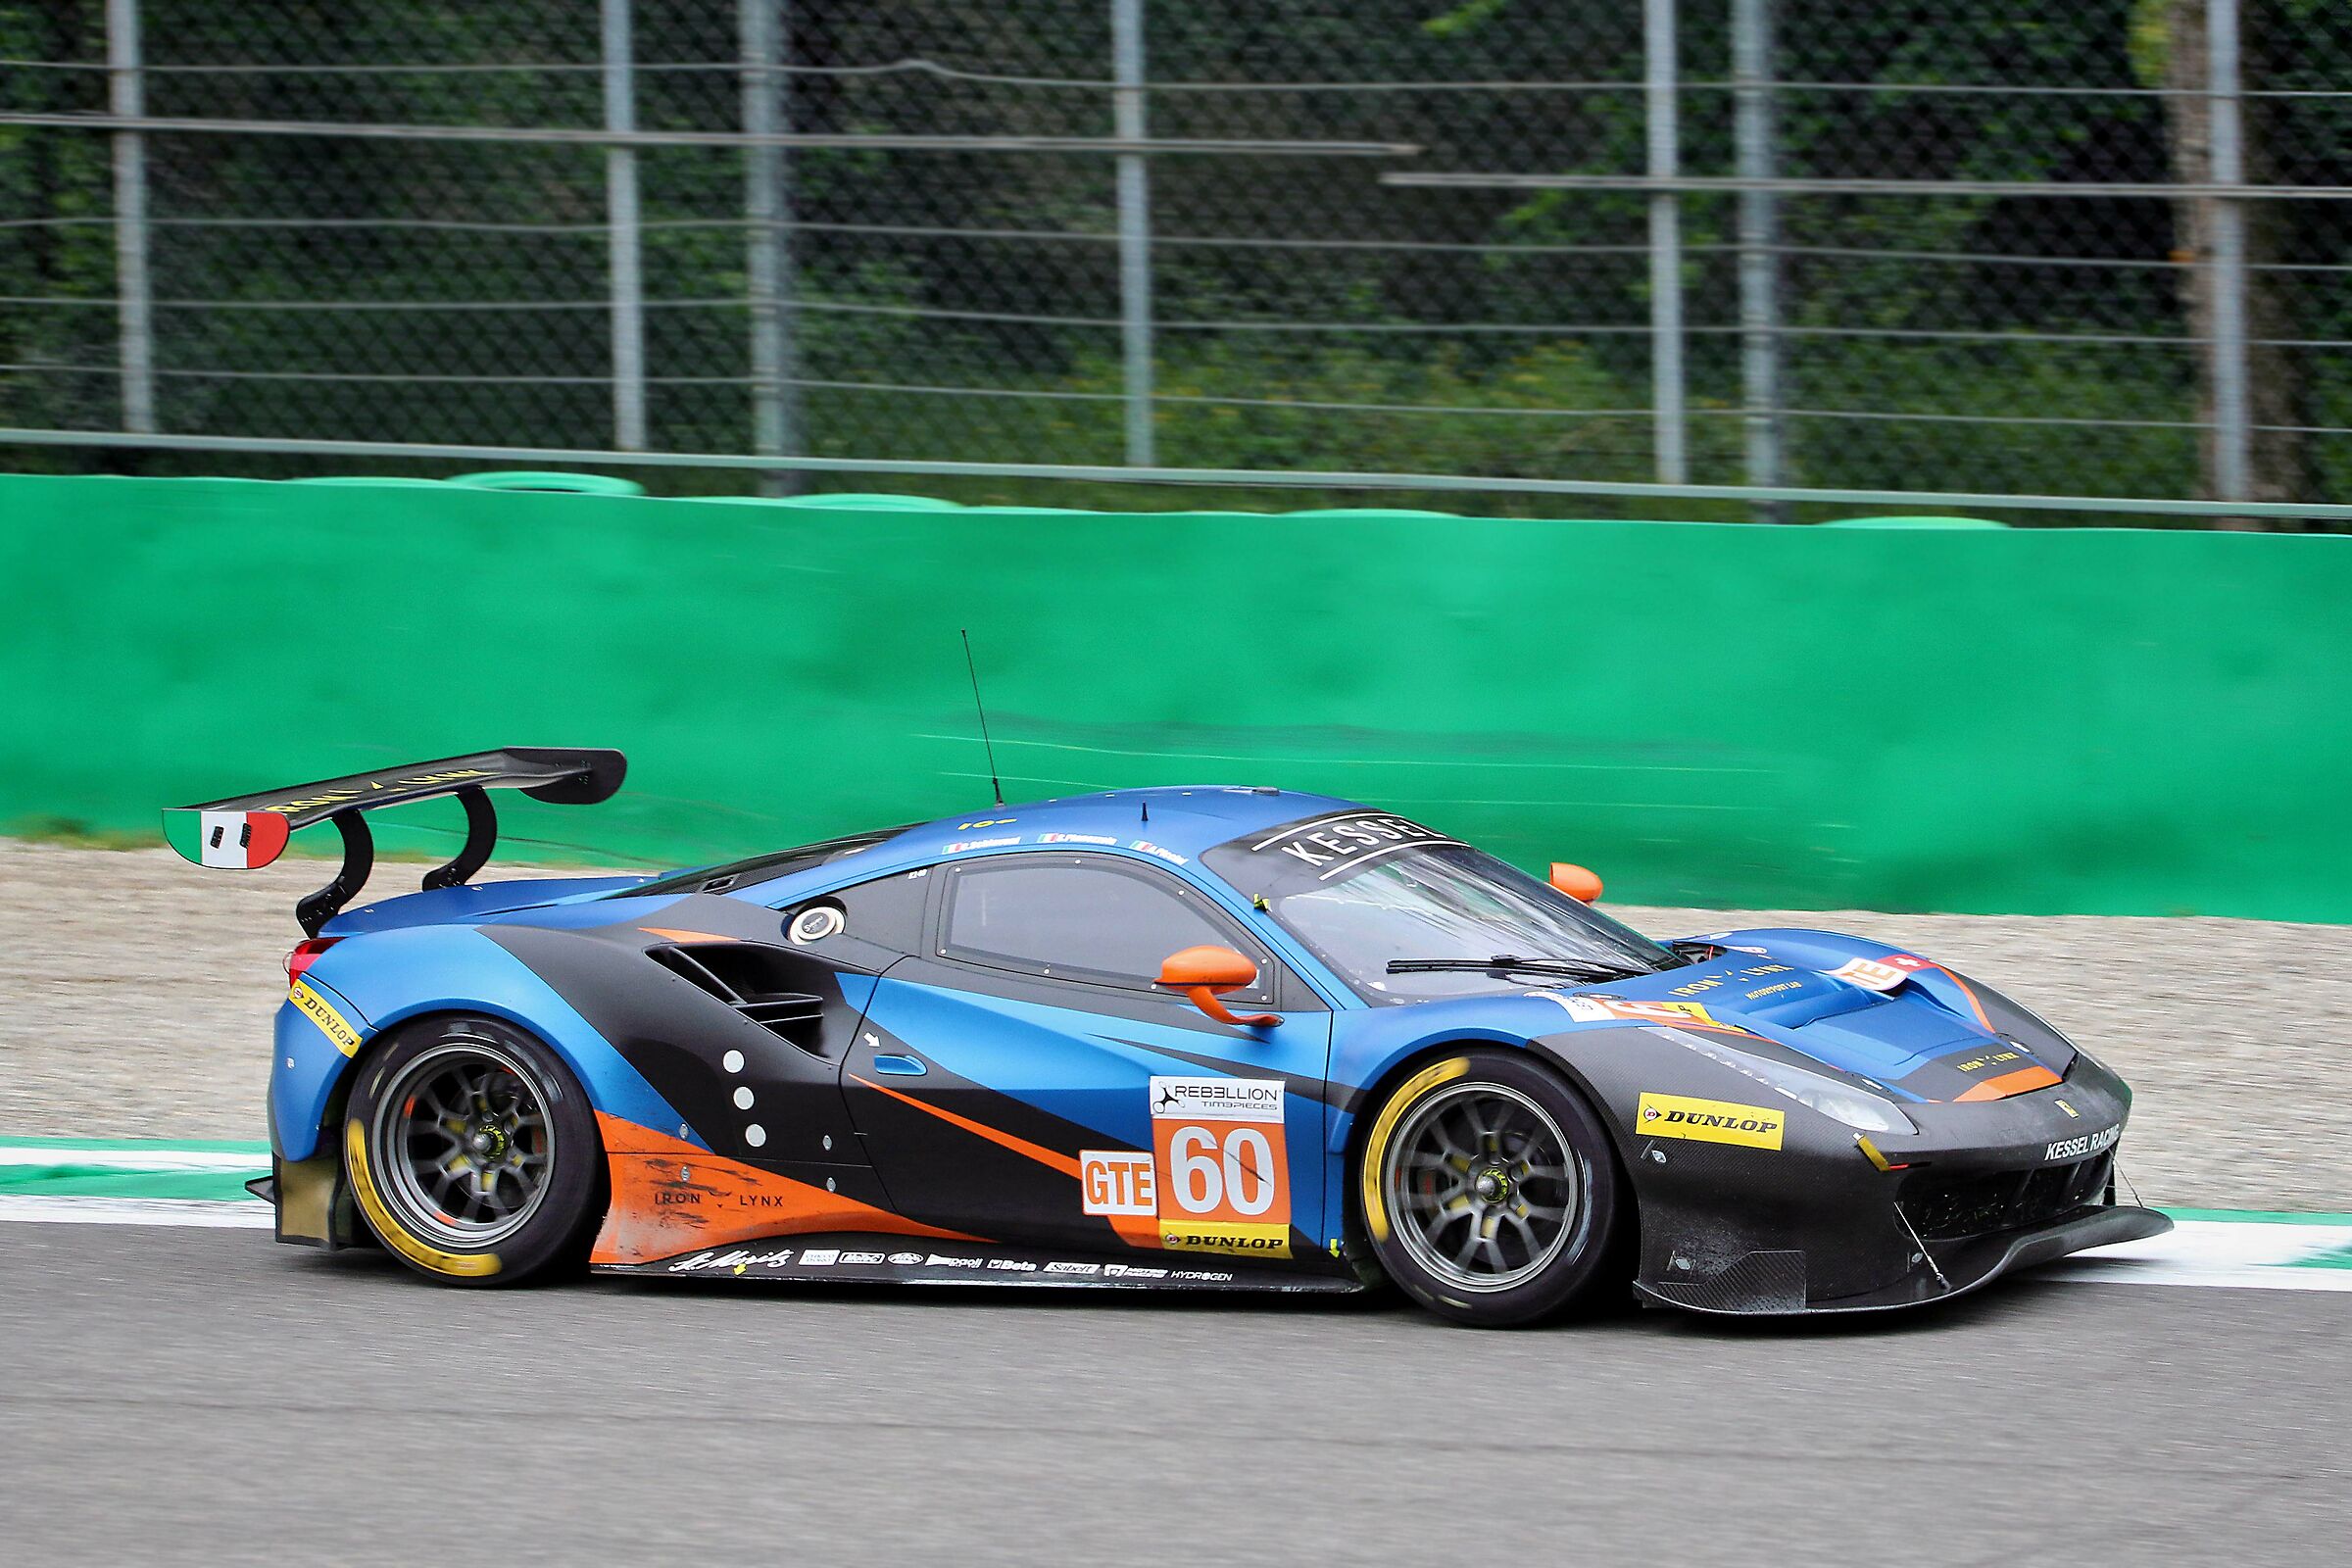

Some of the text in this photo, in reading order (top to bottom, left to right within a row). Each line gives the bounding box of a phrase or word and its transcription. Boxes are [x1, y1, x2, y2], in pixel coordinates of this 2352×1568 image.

[265, 795, 360, 813] RON
[1667, 964, 1795, 998] IRON LYNX
[304, 997, 355, 1046] DUNLOP
[1956, 1059, 1985, 1072] IRON
[1664, 1110, 1778, 1133] DUNLOP
[2044, 1136, 2089, 1161] KESSEL
[1170, 1126, 1275, 1216] 60
[1085, 1160, 1153, 1206] GTE
[655, 1192, 784, 1207] IRON LYNX
[1186, 1235, 1284, 1250] DUNLOP
[1001, 1259, 1038, 1273] Beta
[1170, 1270, 1233, 1282] HYDROGEN
